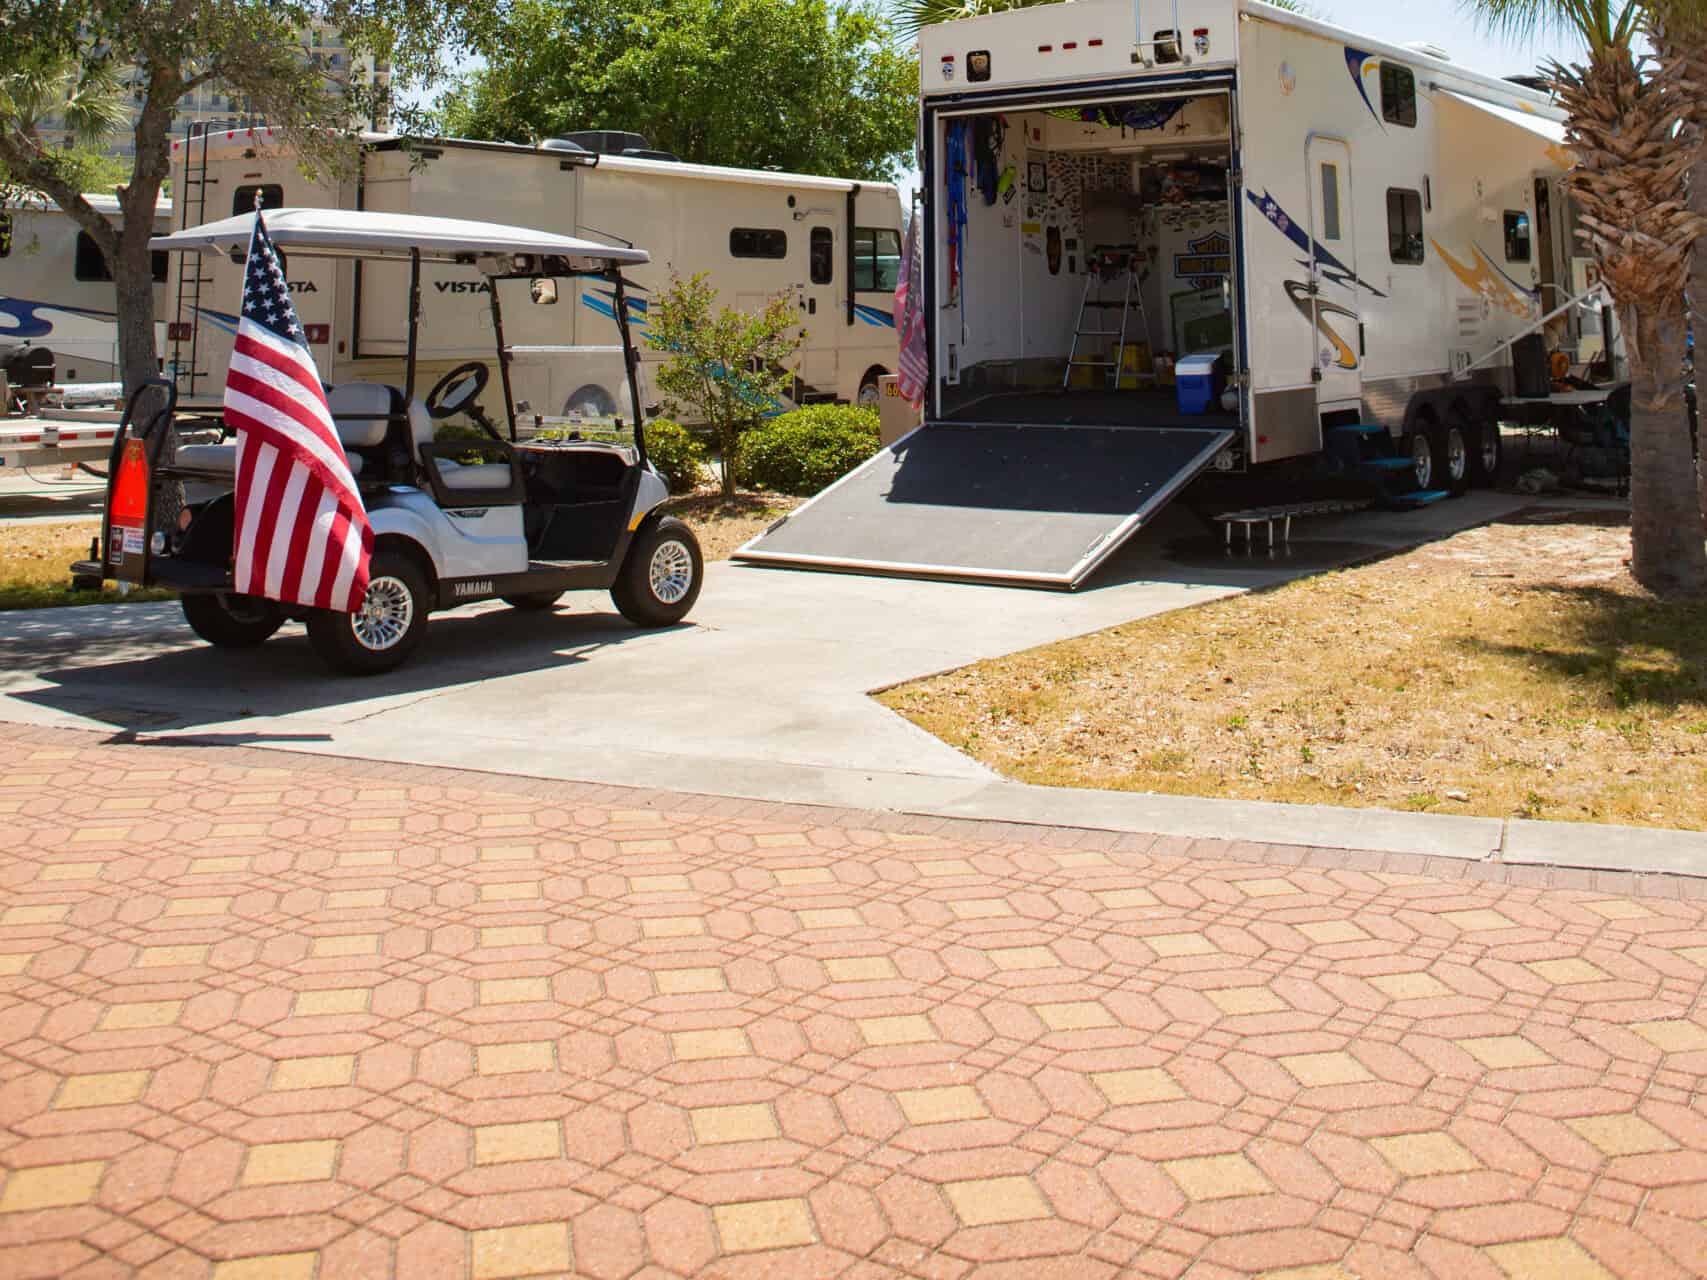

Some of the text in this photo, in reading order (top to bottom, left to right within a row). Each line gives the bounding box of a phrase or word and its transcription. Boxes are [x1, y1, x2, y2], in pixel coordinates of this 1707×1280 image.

[287, 281, 318, 293] STA
[434, 281, 491, 293] VISTA
[455, 580, 494, 596] YAMAHA
